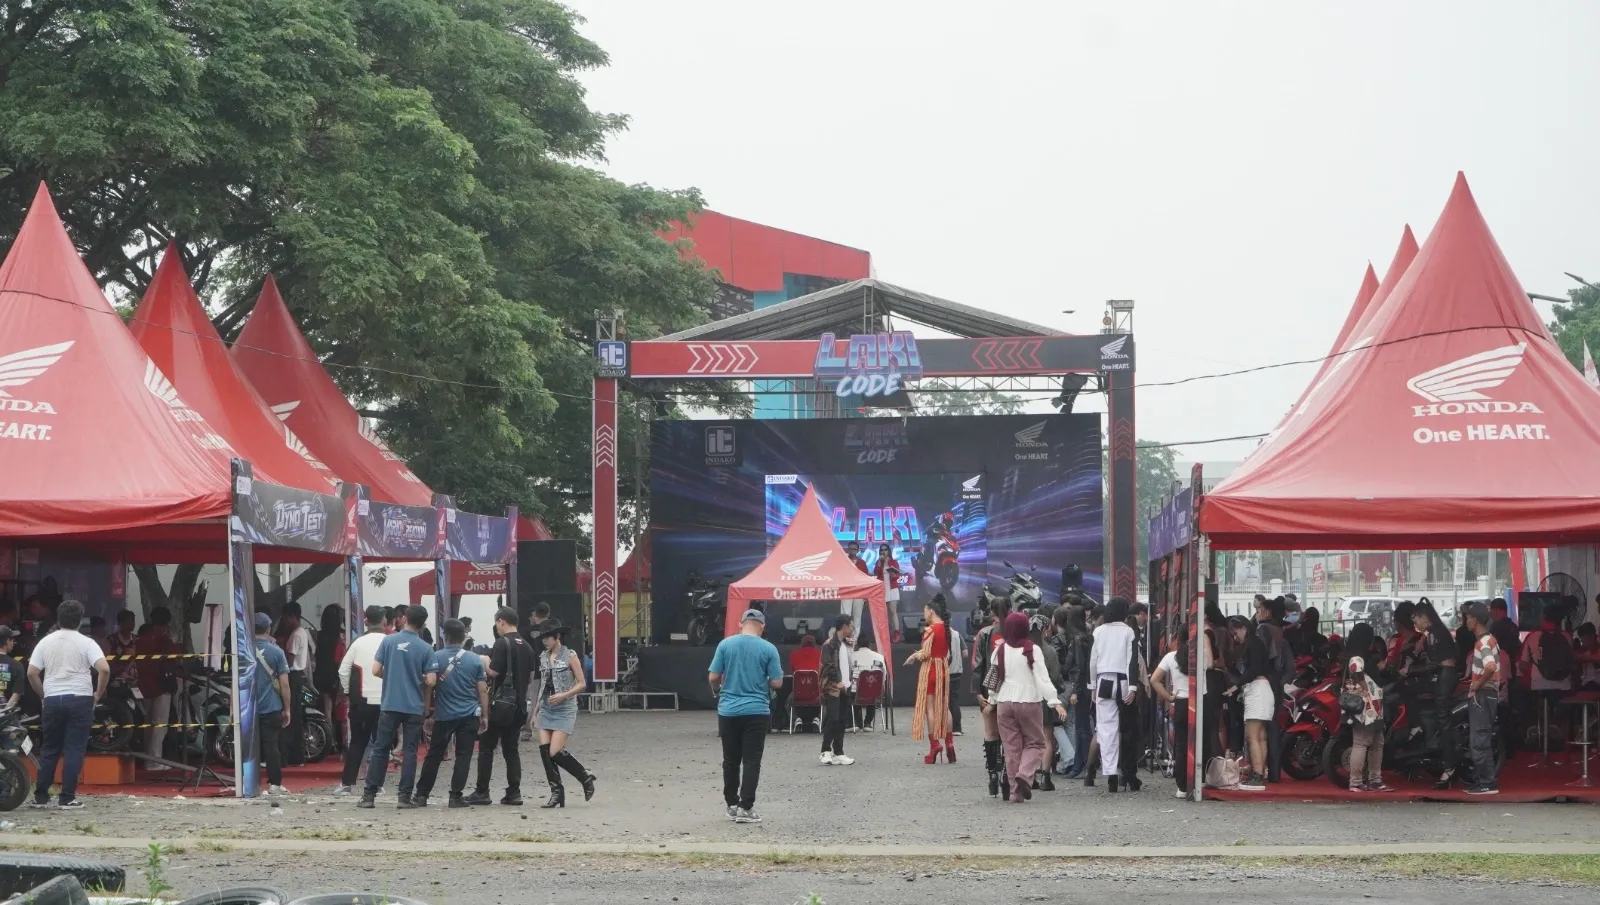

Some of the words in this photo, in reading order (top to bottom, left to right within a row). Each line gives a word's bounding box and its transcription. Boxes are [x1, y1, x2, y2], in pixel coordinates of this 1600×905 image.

[815, 330, 924, 378] LAKI
[836, 373, 901, 397] CODE
[1412, 402, 1544, 417] HONDA
[1413, 427, 1462, 444] One
[1466, 424, 1550, 441] HEART.
[705, 456, 736, 465] INDAKO
[857, 449, 897, 464] CODE
[300, 501, 323, 533] TEST
[832, 506, 920, 548] LAKI
[465, 580, 486, 591] One
[773, 587, 797, 600] One
[800, 587, 840, 600] HEART.
